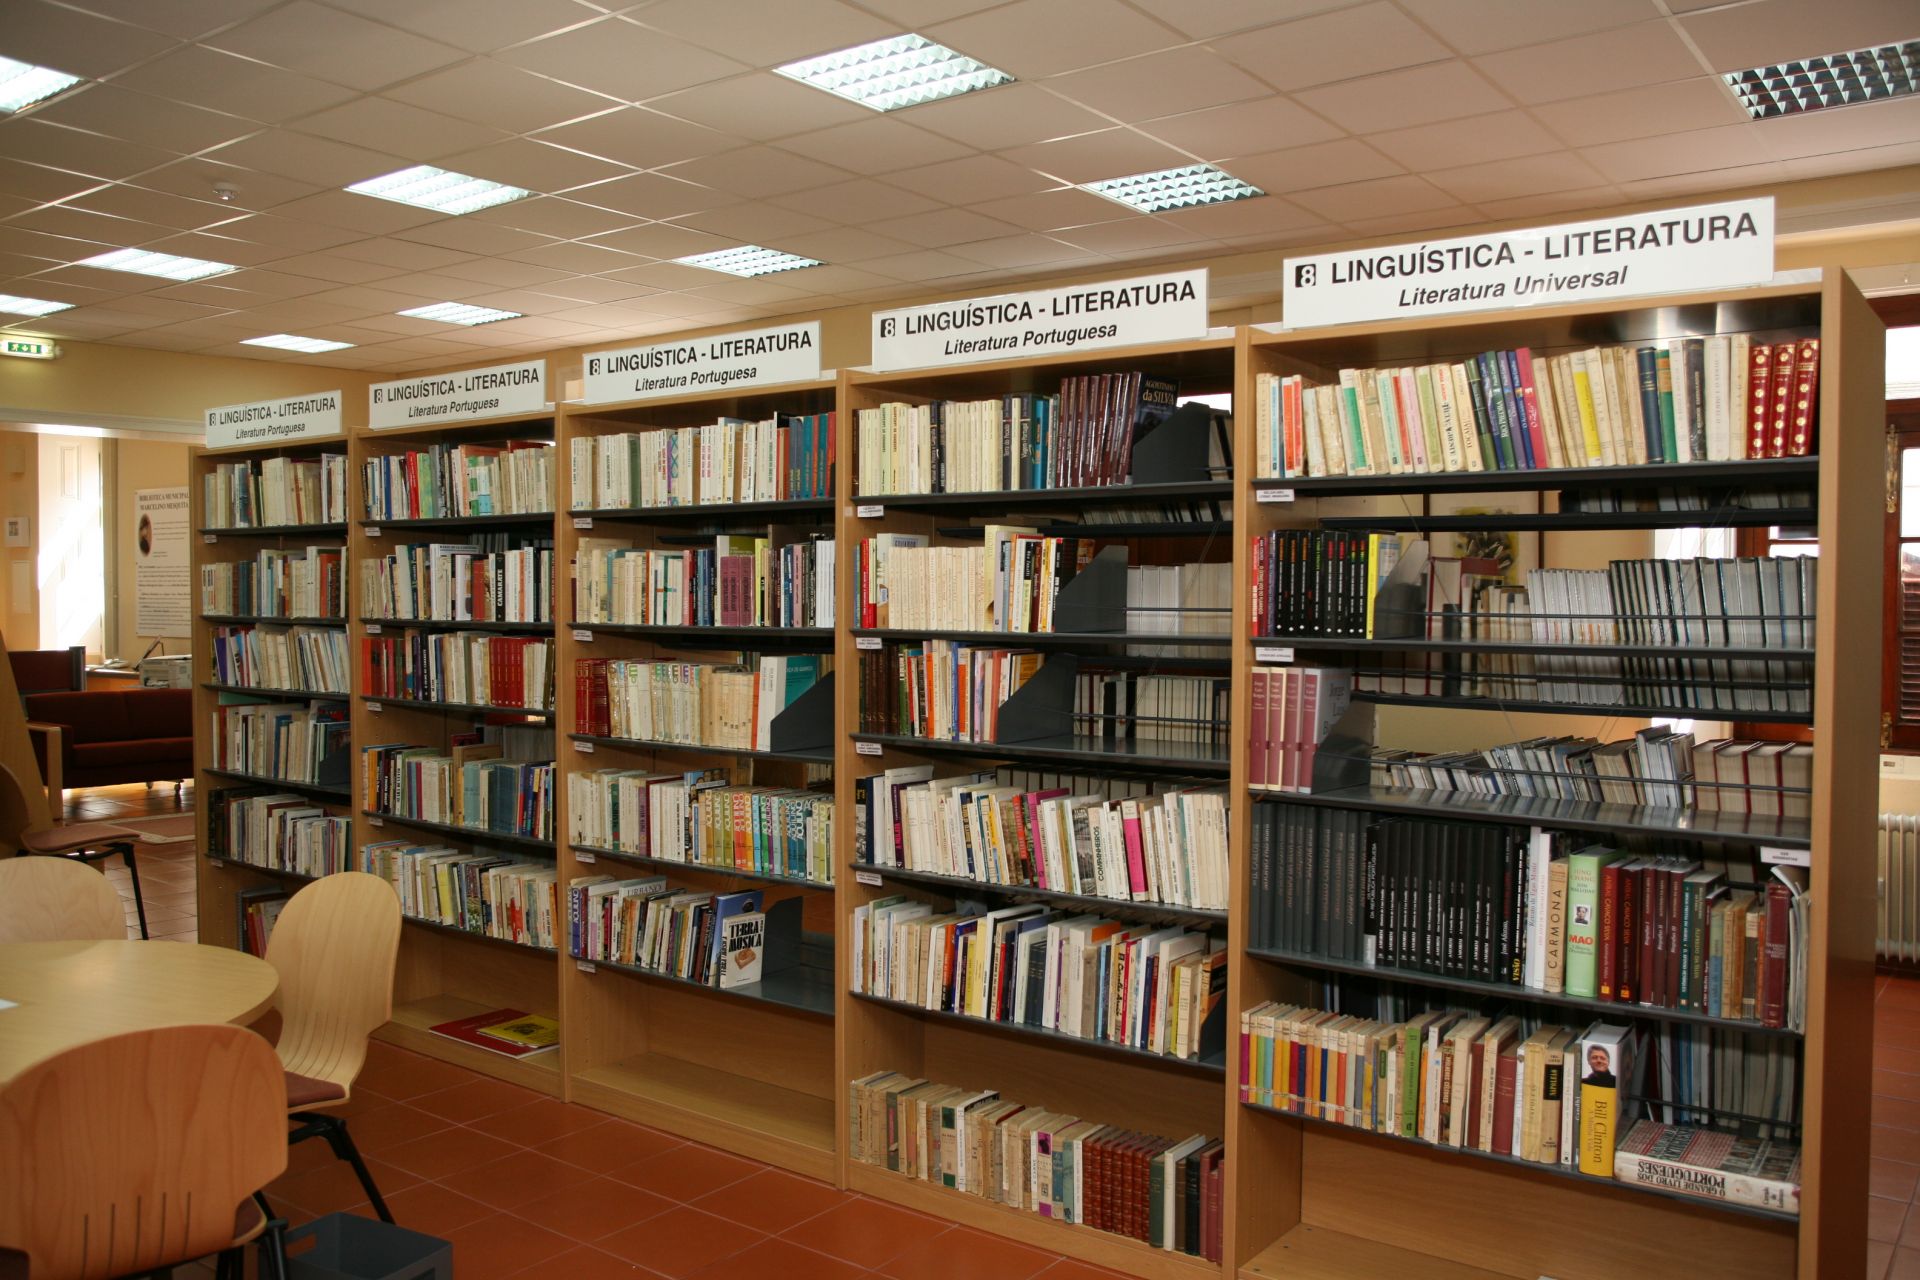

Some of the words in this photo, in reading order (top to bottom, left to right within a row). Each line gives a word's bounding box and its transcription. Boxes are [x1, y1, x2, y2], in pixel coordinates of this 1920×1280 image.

[1295, 264, 1316, 287] 8
[1333, 243, 1514, 283] LINGUÍSTICA
[1546, 213, 1756, 259] LITERATURA
[1400, 284, 1505, 306] Literatura
[1515, 266, 1627, 290] Universal
[881, 318, 896, 337] 8
[906, 302, 1032, 334] LINGUÍSTICA
[1053, 281, 1195, 316] LITERATURA
[945, 337, 1017, 355] Literatura
[1023, 325, 1117, 346] Portuguesa
[590, 359, 601, 375] 8
[608, 347, 697, 374] LINGUÍSTICA
[711, 331, 811, 360] LITERATURA
[374, 389, 383, 403] 8
[388, 380, 455, 402] LINGUÍSTICA
[466, 368, 538, 391] LITERATURA
[636, 376, 686, 391] Literatura
[691, 368, 756, 384] Portuguesa
[409, 404, 447, 417] Literatura
[450, 399, 499, 413] Portuguesa
[1143, 390, 1152, 401] da
[1153, 390, 1174, 405] SILVA
[219, 407, 272, 425] LINGUÍSTICA
[279, 397, 336, 417] LITERATURA
[236, 428, 266, 439] Literatura
[268, 424, 305, 436] Portuguesa
[1021, 423, 1029, 440] Portugal
[139, 493, 164, 502] BIBLIOTECA
[140, 502, 166, 511] MARCELINO
[167, 501, 188, 510] MESQUITA
[1093, 826, 1105, 881] COMPANHEIROS
[1603, 899, 1612, 925] CAVACO
[1623, 902, 1631, 927] CAVACO
[1548, 889, 1562, 968] CARMONA
[1569, 936, 1593, 944] MAO
[1512, 958, 1521, 981] VISÃO
[1594, 1100, 1608, 1119] Bill
[1593, 1122, 1607, 1163] Clinton
[1637, 1172, 1655, 1185] DOS
[1638, 1161, 1726, 1188] PORTUGUESES
[1656, 1177, 1682, 1190] LIVRO
[1683, 1182, 1718, 1195] GRANDE
